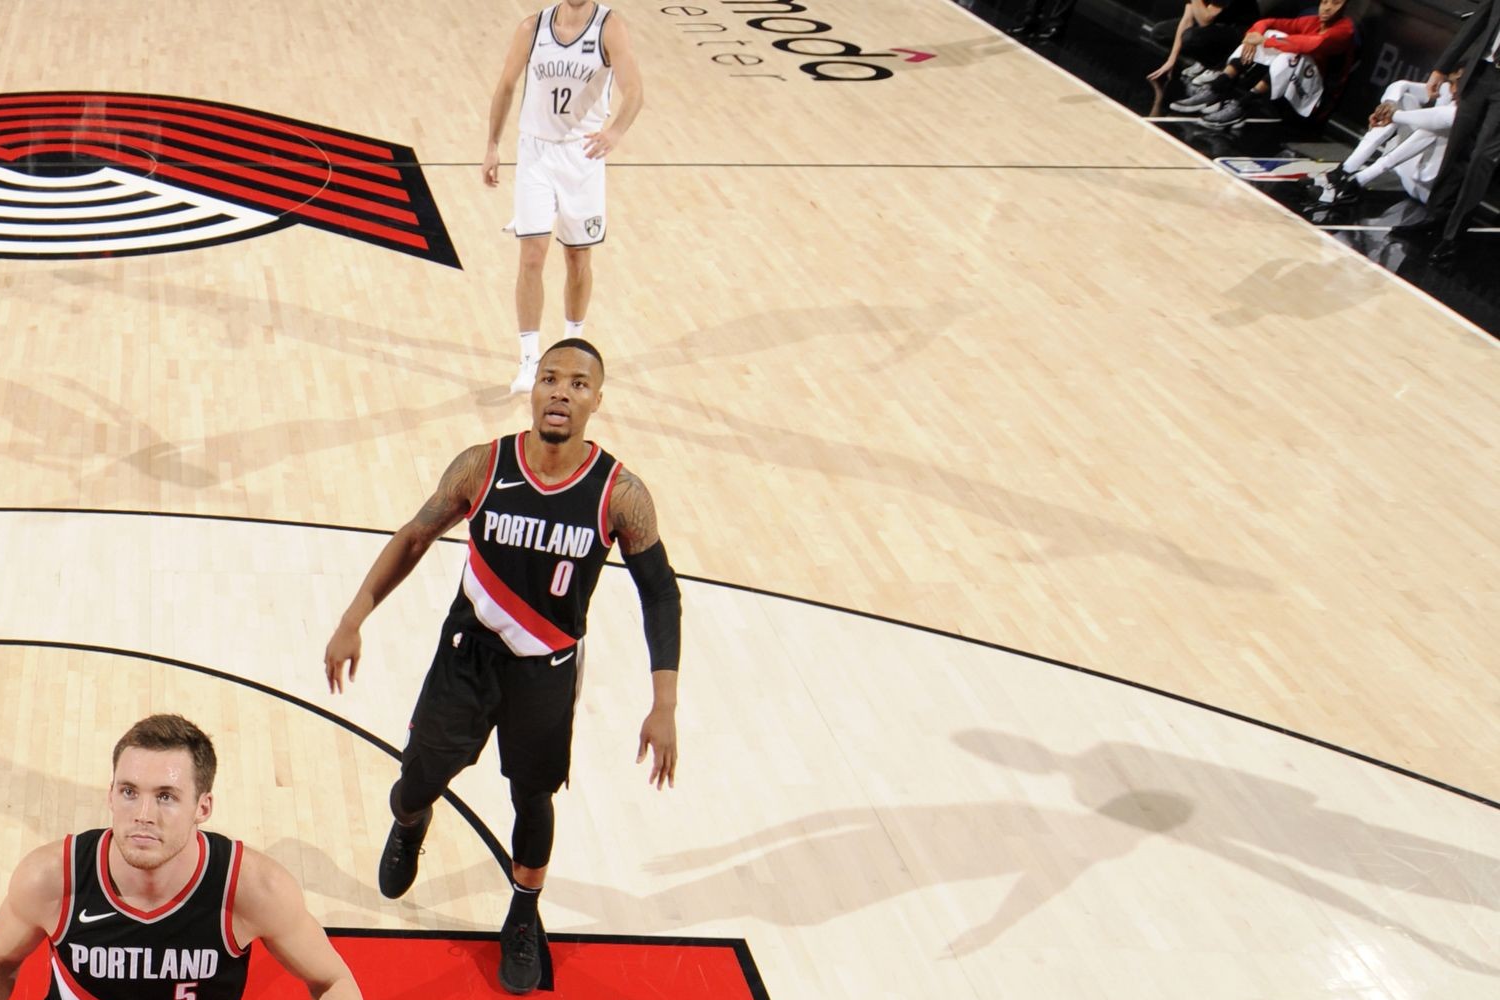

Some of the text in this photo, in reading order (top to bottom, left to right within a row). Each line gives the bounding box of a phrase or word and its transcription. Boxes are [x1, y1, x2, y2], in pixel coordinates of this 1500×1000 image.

[533, 60, 596, 84] BROOKLYN
[551, 87, 572, 114] 12
[483, 510, 595, 558] PORTLAND
[550, 560, 574, 597] 0
[68, 943, 218, 980] PORTLAND
